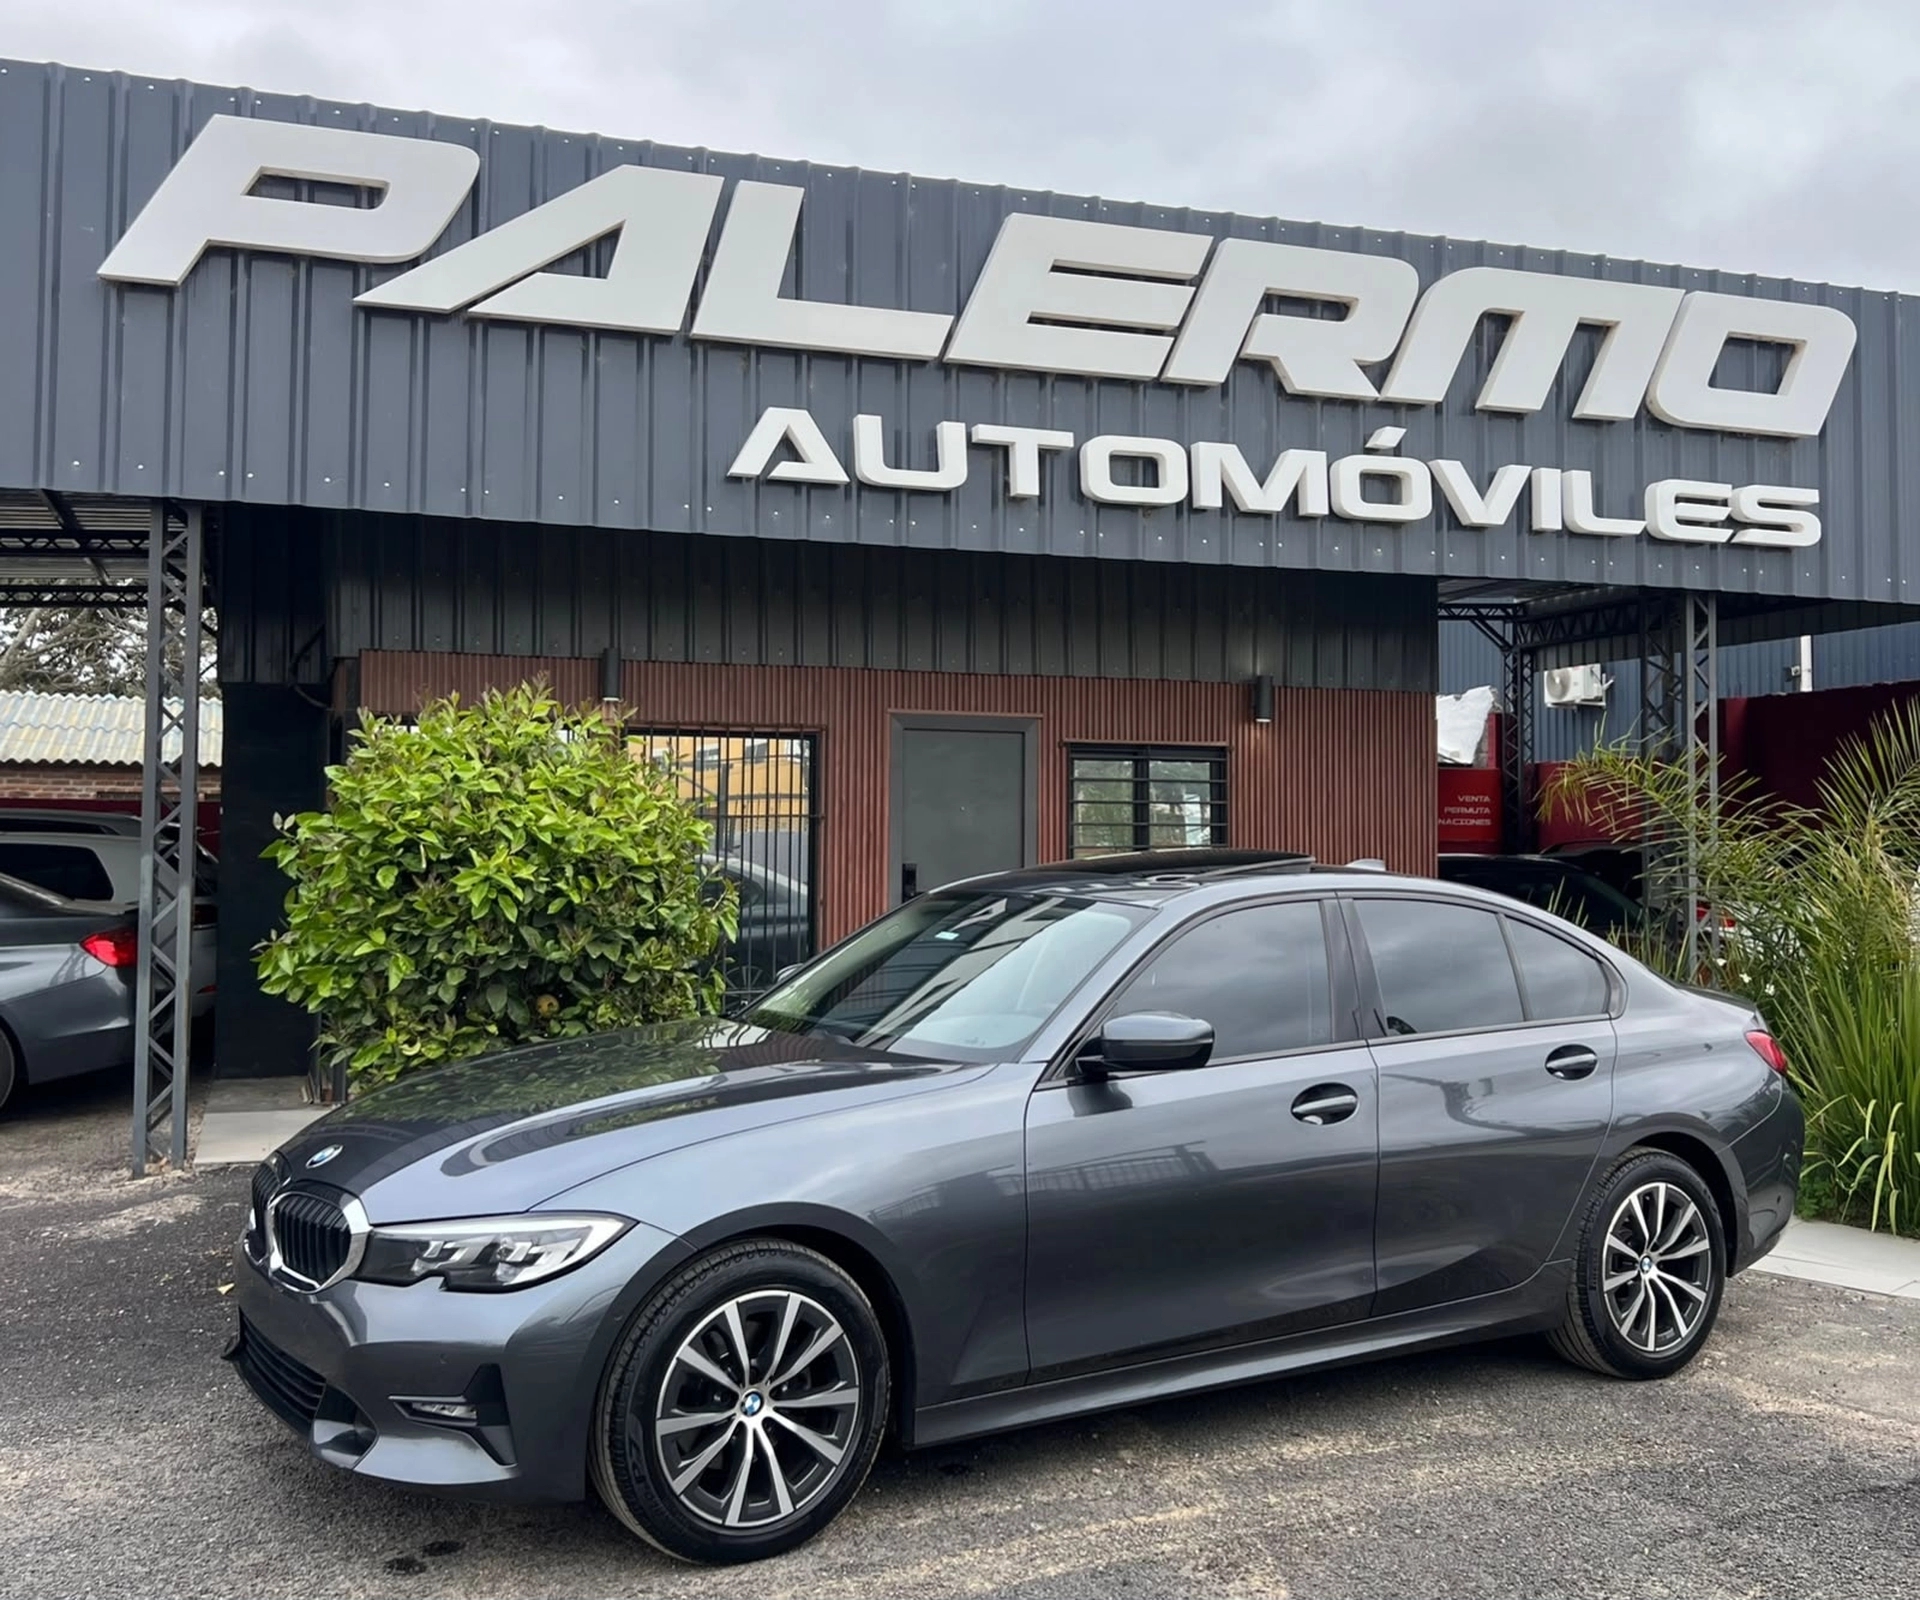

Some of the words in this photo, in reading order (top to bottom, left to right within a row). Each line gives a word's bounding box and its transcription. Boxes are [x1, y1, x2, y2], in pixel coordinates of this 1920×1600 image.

[97, 113, 1859, 438] PALERMO
[728, 406, 1823, 549] AUTOMÓVILES
[1444, 806, 1490, 814] PERMUTA
